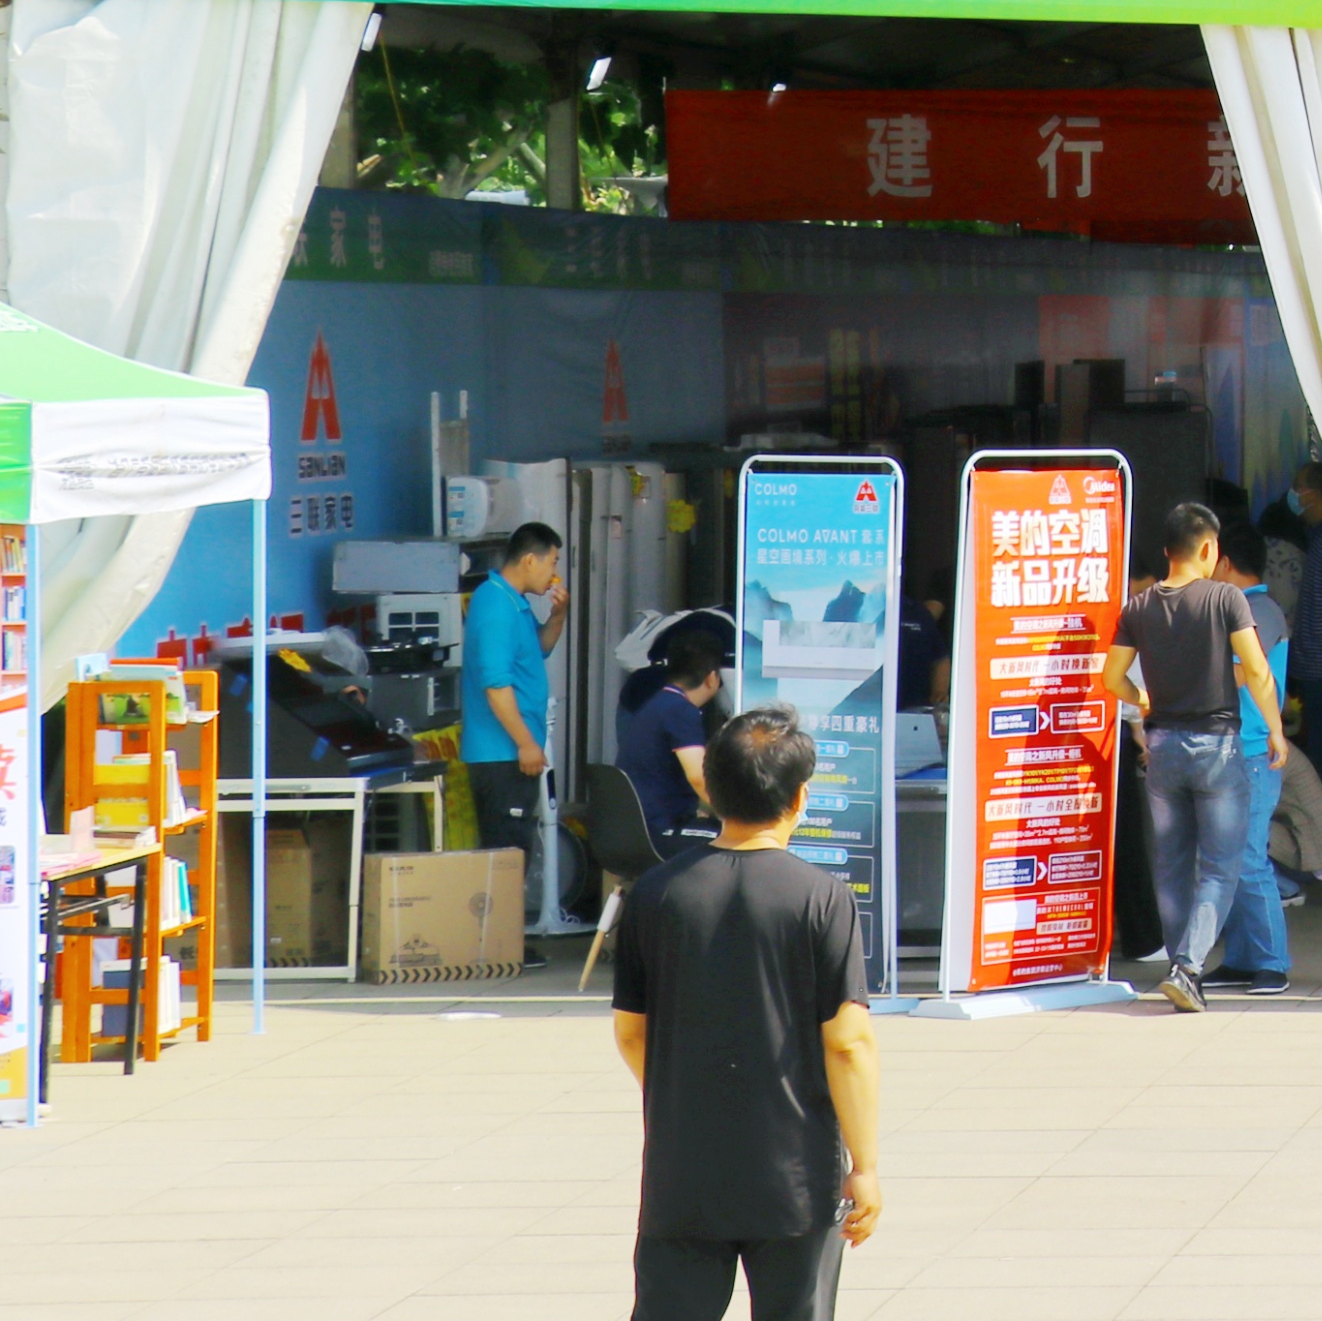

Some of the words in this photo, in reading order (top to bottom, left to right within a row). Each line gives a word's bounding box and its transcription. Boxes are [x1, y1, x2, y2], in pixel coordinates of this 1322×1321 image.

[754, 483, 798, 496] COLMO
[757, 528, 809, 543] COLMO
[813, 529, 858, 544] AVANT
[991, 508, 1109, 557] 美的空调
[990, 557, 1110, 607] 新品升级
